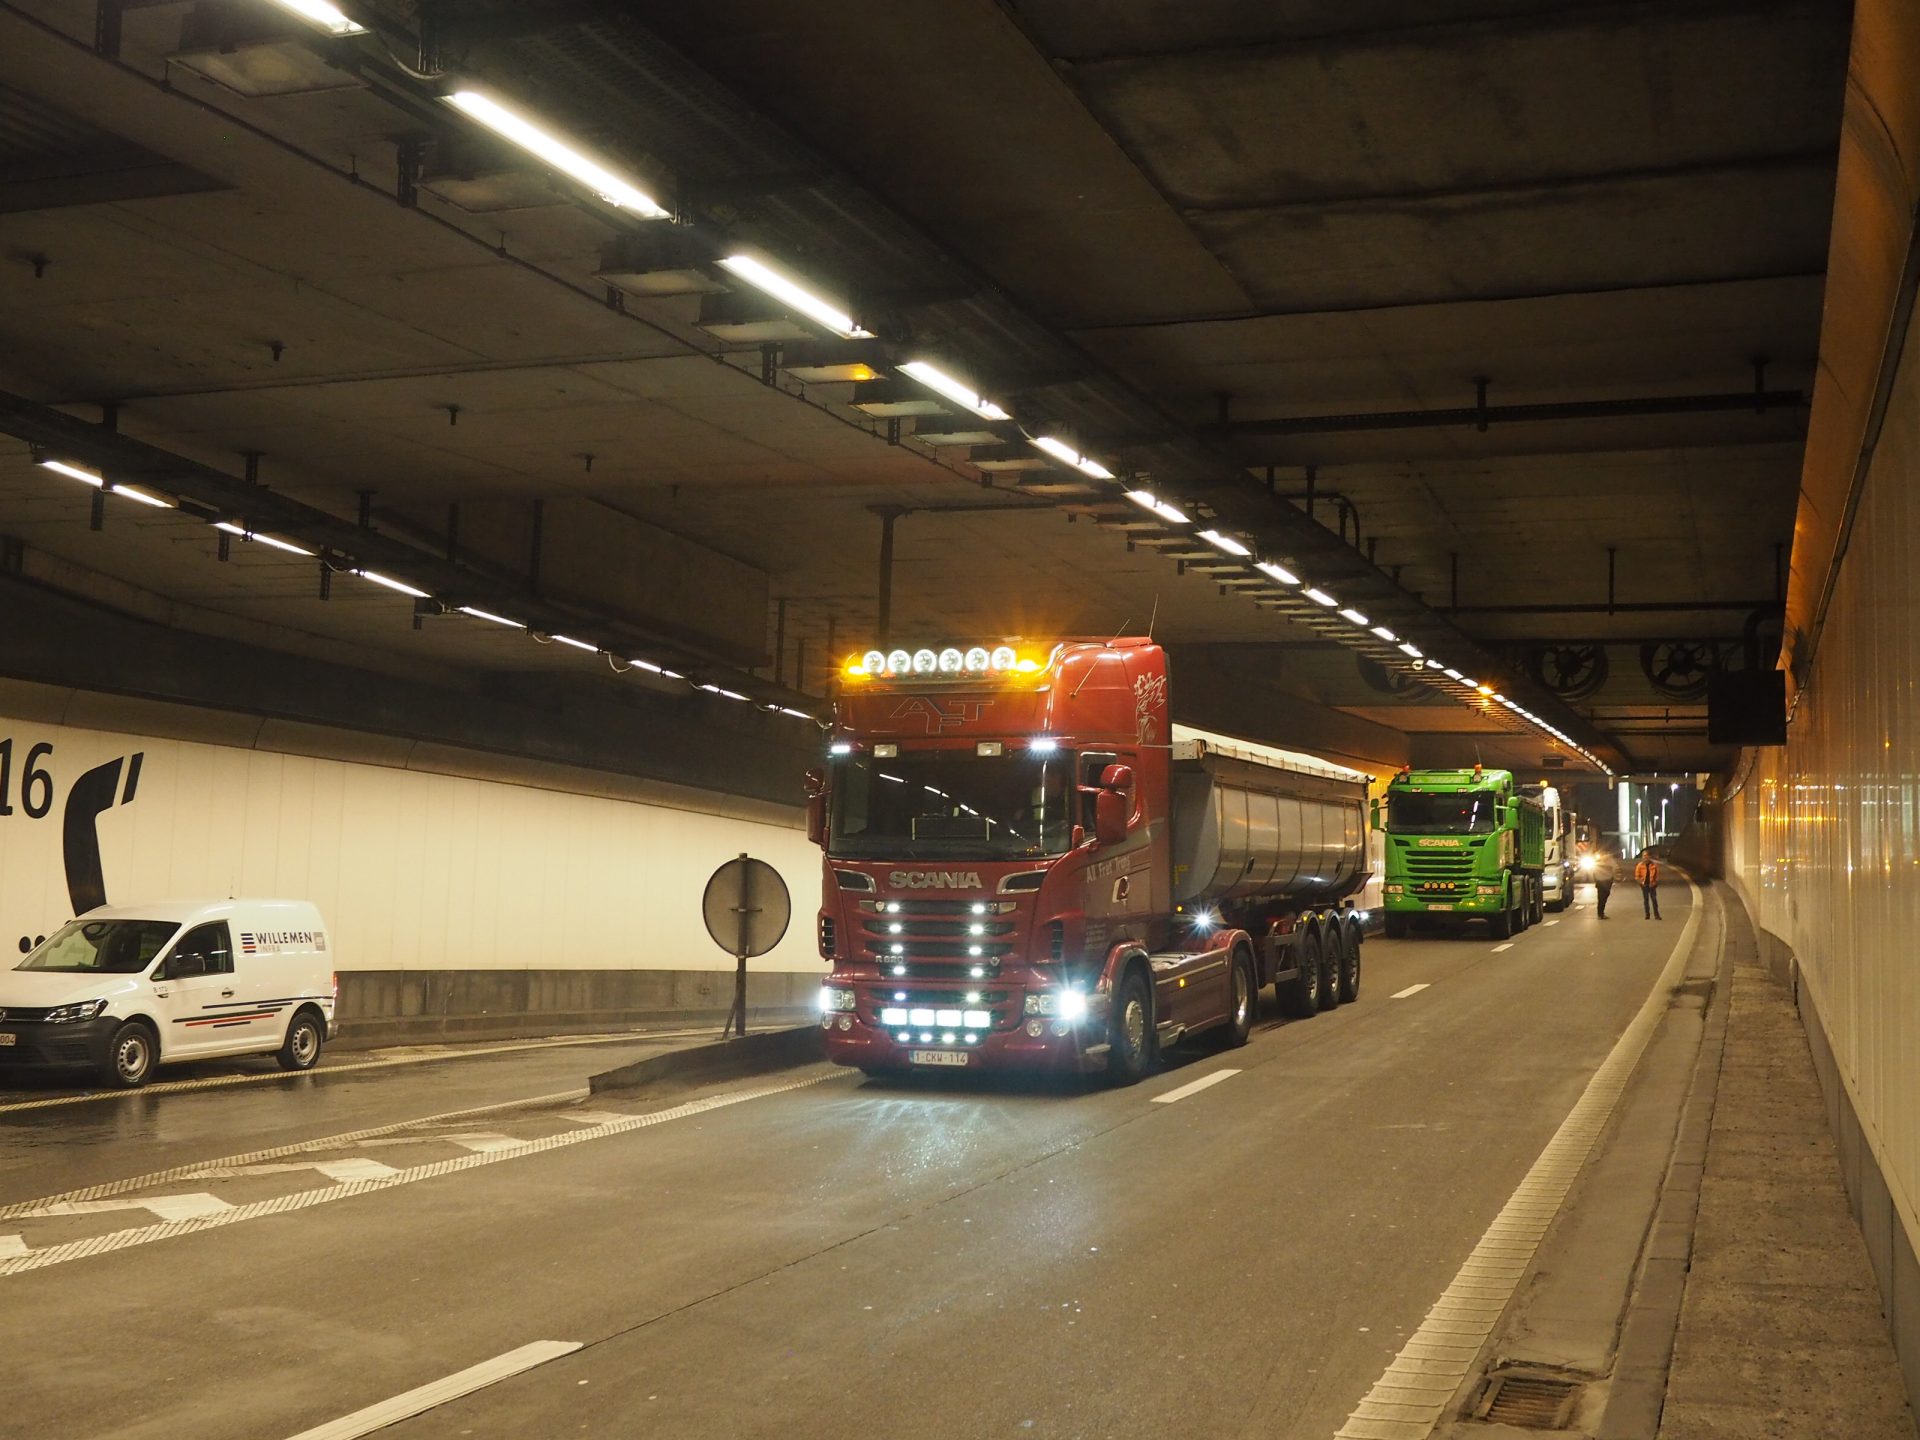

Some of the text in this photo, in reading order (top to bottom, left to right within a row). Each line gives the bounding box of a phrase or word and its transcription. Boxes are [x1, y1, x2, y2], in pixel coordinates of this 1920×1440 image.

[0, 738, 53, 819] 16
[1418, 838, 1460, 847] SCANIA
[889, 871, 982, 888] SCANIA
[255, 932, 313, 944] WILLEMEN
